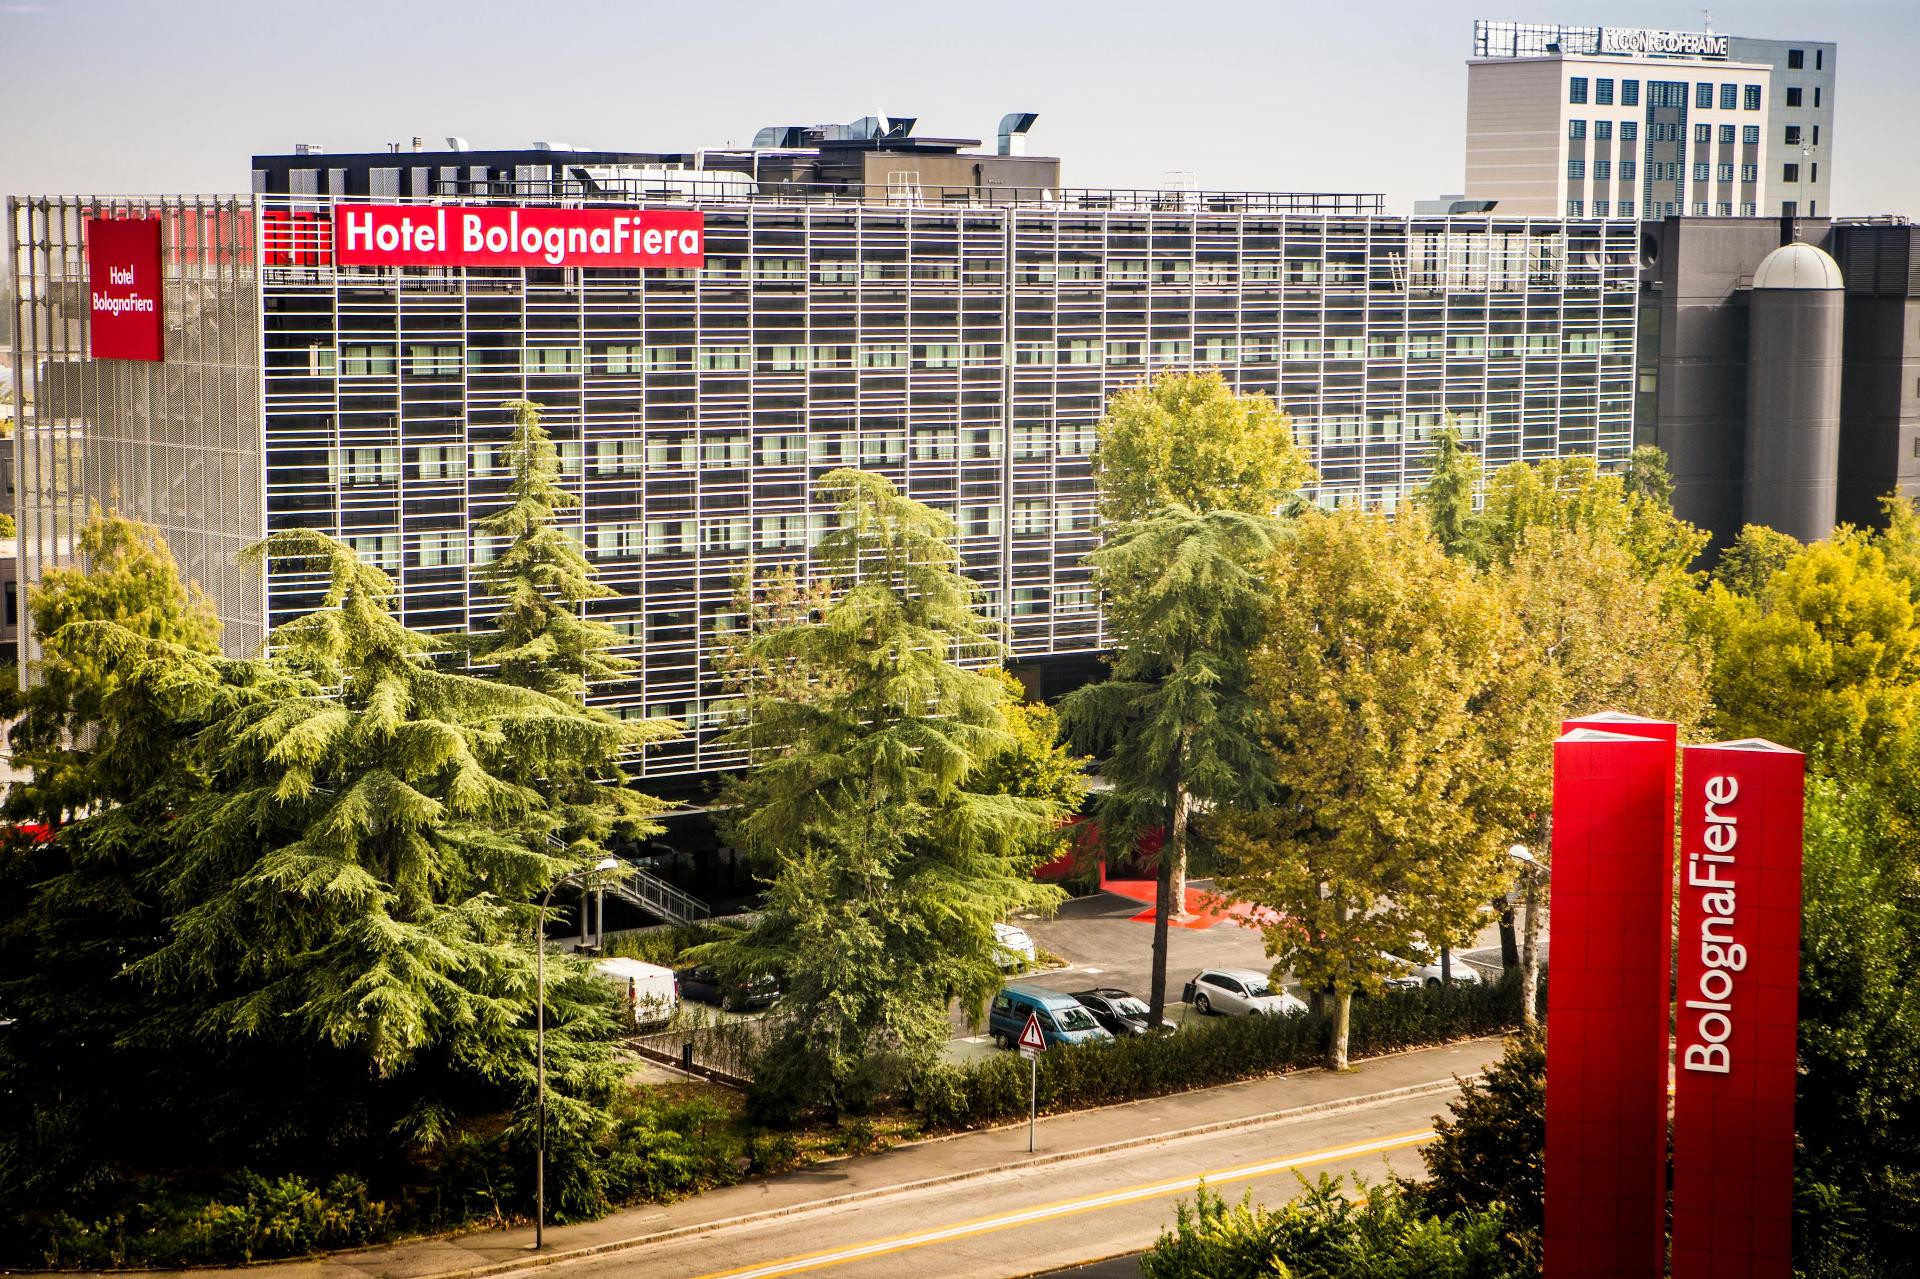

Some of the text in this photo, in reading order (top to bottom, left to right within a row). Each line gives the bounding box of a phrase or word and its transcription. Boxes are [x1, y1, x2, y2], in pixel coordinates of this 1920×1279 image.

[346, 209, 700, 265] Hotel BolognaFiera
[110, 264, 134, 285] Hotel
[92, 290, 153, 317] BolognaFiera
[1684, 775, 1747, 1074] BolognaFiere
